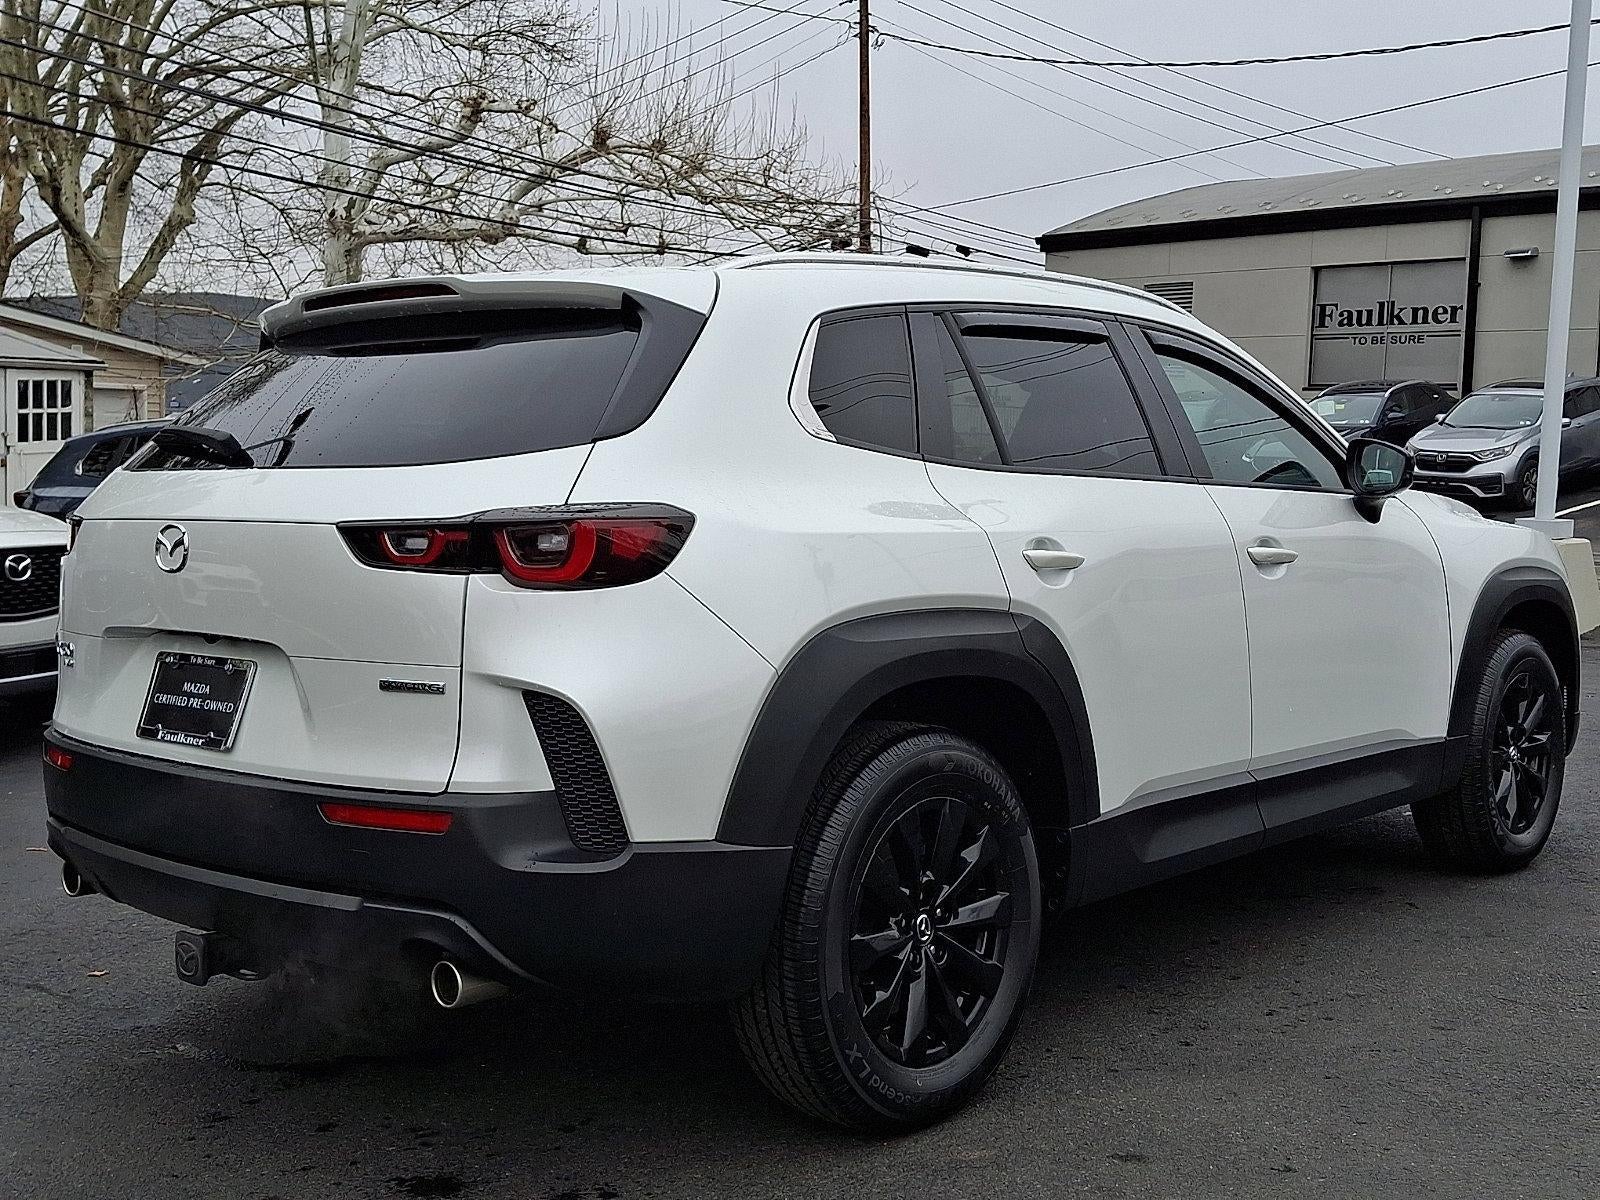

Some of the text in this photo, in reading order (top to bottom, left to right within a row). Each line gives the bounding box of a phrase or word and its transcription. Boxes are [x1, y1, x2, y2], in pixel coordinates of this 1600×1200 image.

[1315, 300, 1464, 328] Faulkner
[1351, 335, 1426, 345] TO BE SURE
[190, 655, 197, 663] To
[197, 656, 204, 664] Be
[182, 681, 211, 695] MAZDA
[153, 693, 234, 713] CERTIFIED PRE-OWNED
[157, 730, 206, 746] Faulkner
